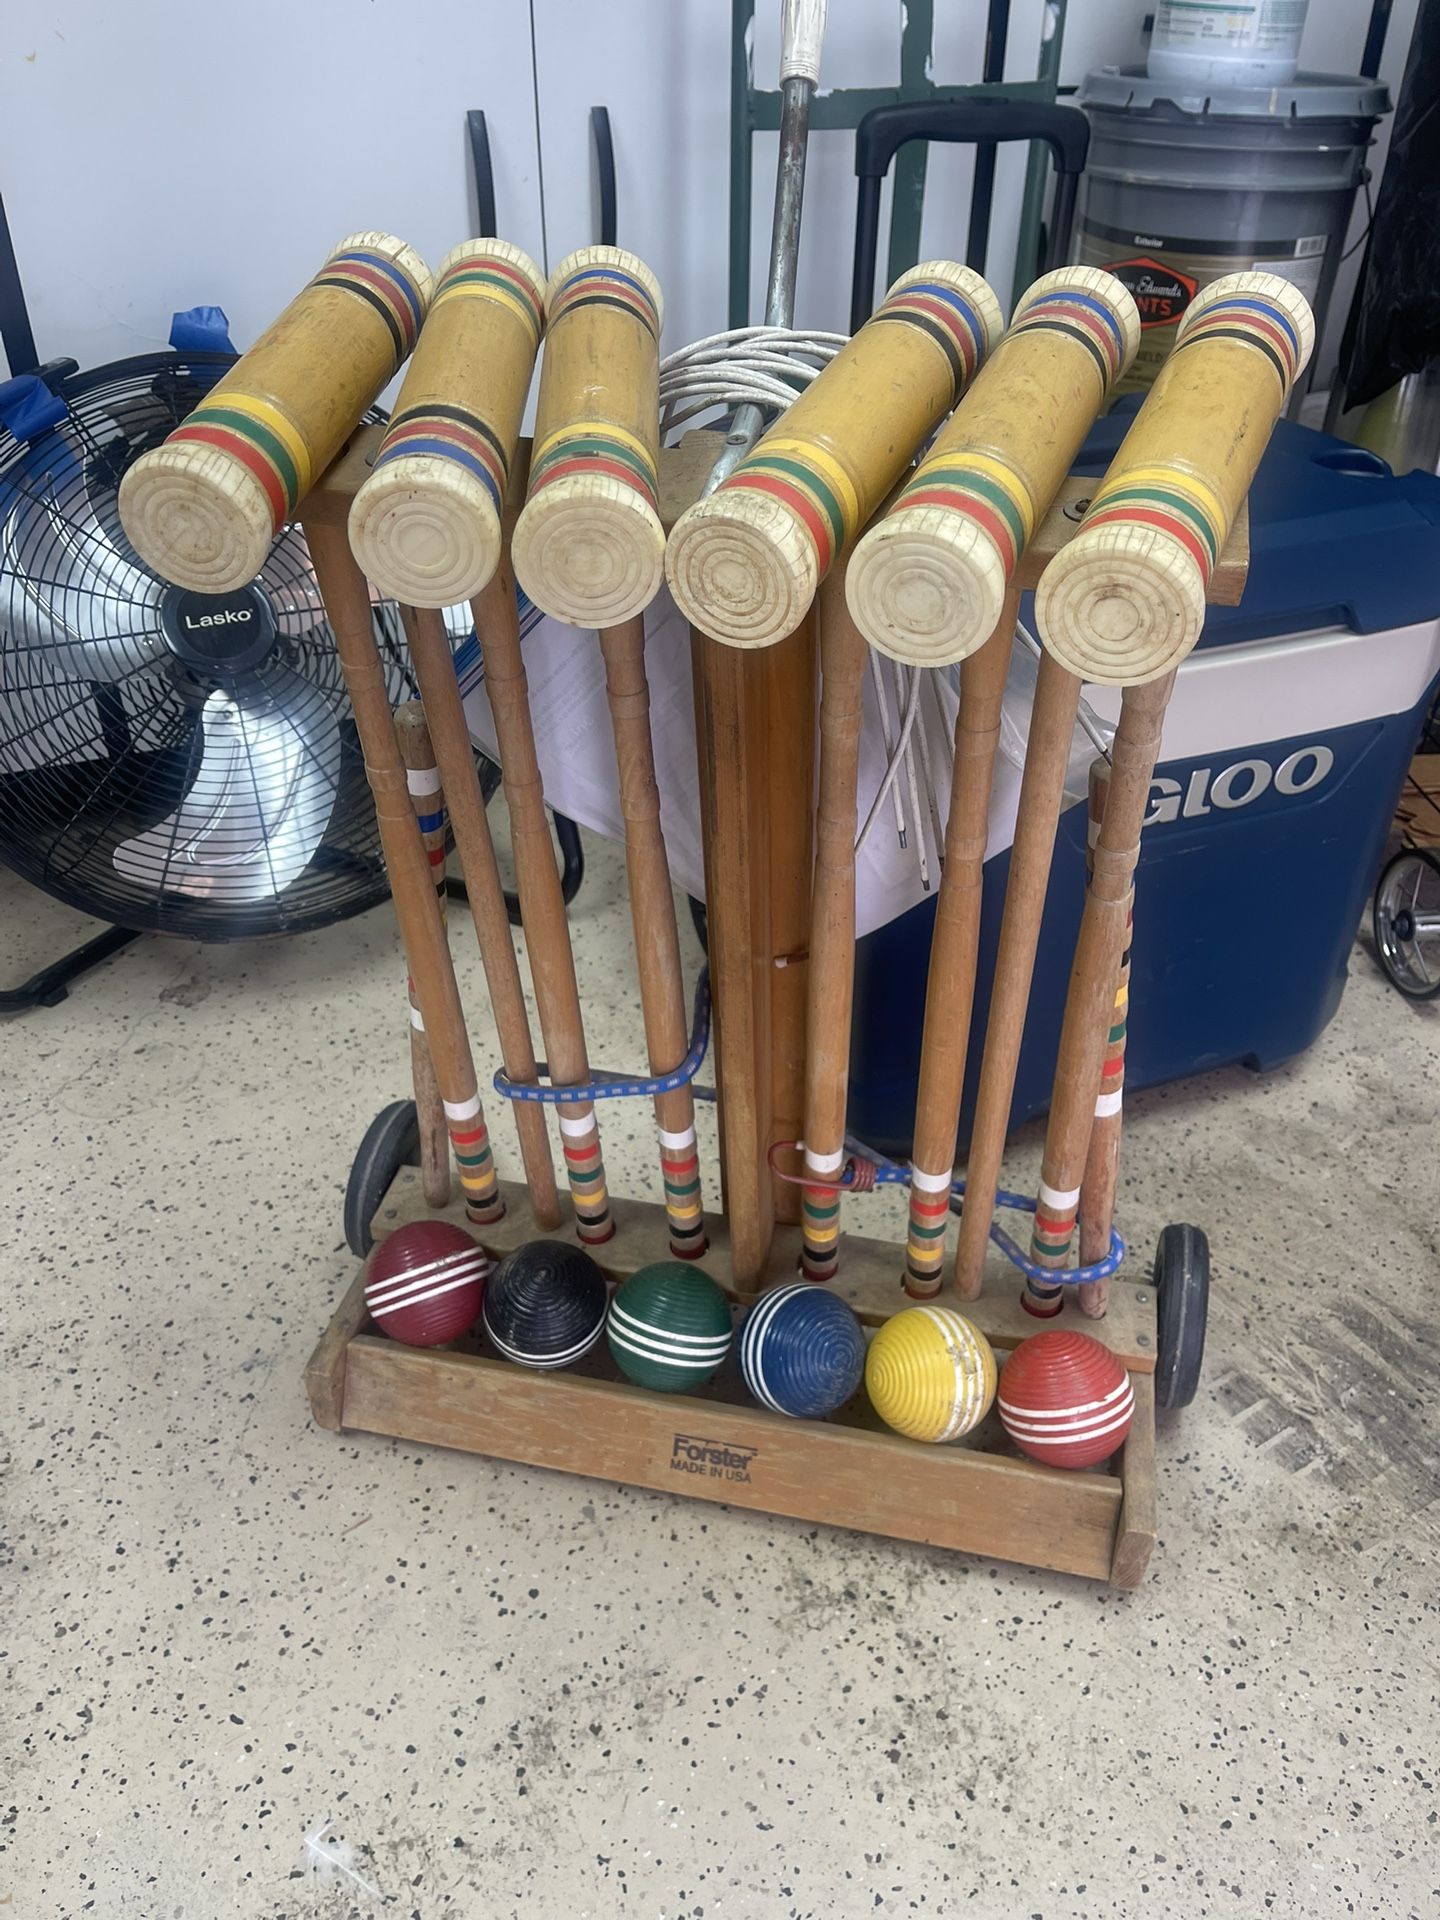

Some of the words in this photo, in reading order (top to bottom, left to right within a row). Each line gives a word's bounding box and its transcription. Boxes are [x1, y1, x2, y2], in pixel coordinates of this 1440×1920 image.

[1134, 235, 1163, 248] Exterior
[1136, 276, 1181, 298] Edwards
[1136, 297, 1172, 316] NTS
[185, 610, 251, 629] Lasko
[1142, 745, 1334, 826] GLOO
[673, 1437, 753, 1470] Forster
[670, 1458, 707, 1475] MADE
[710, 1466, 723, 1478] IN
[725, 1470, 752, 1484] USA
